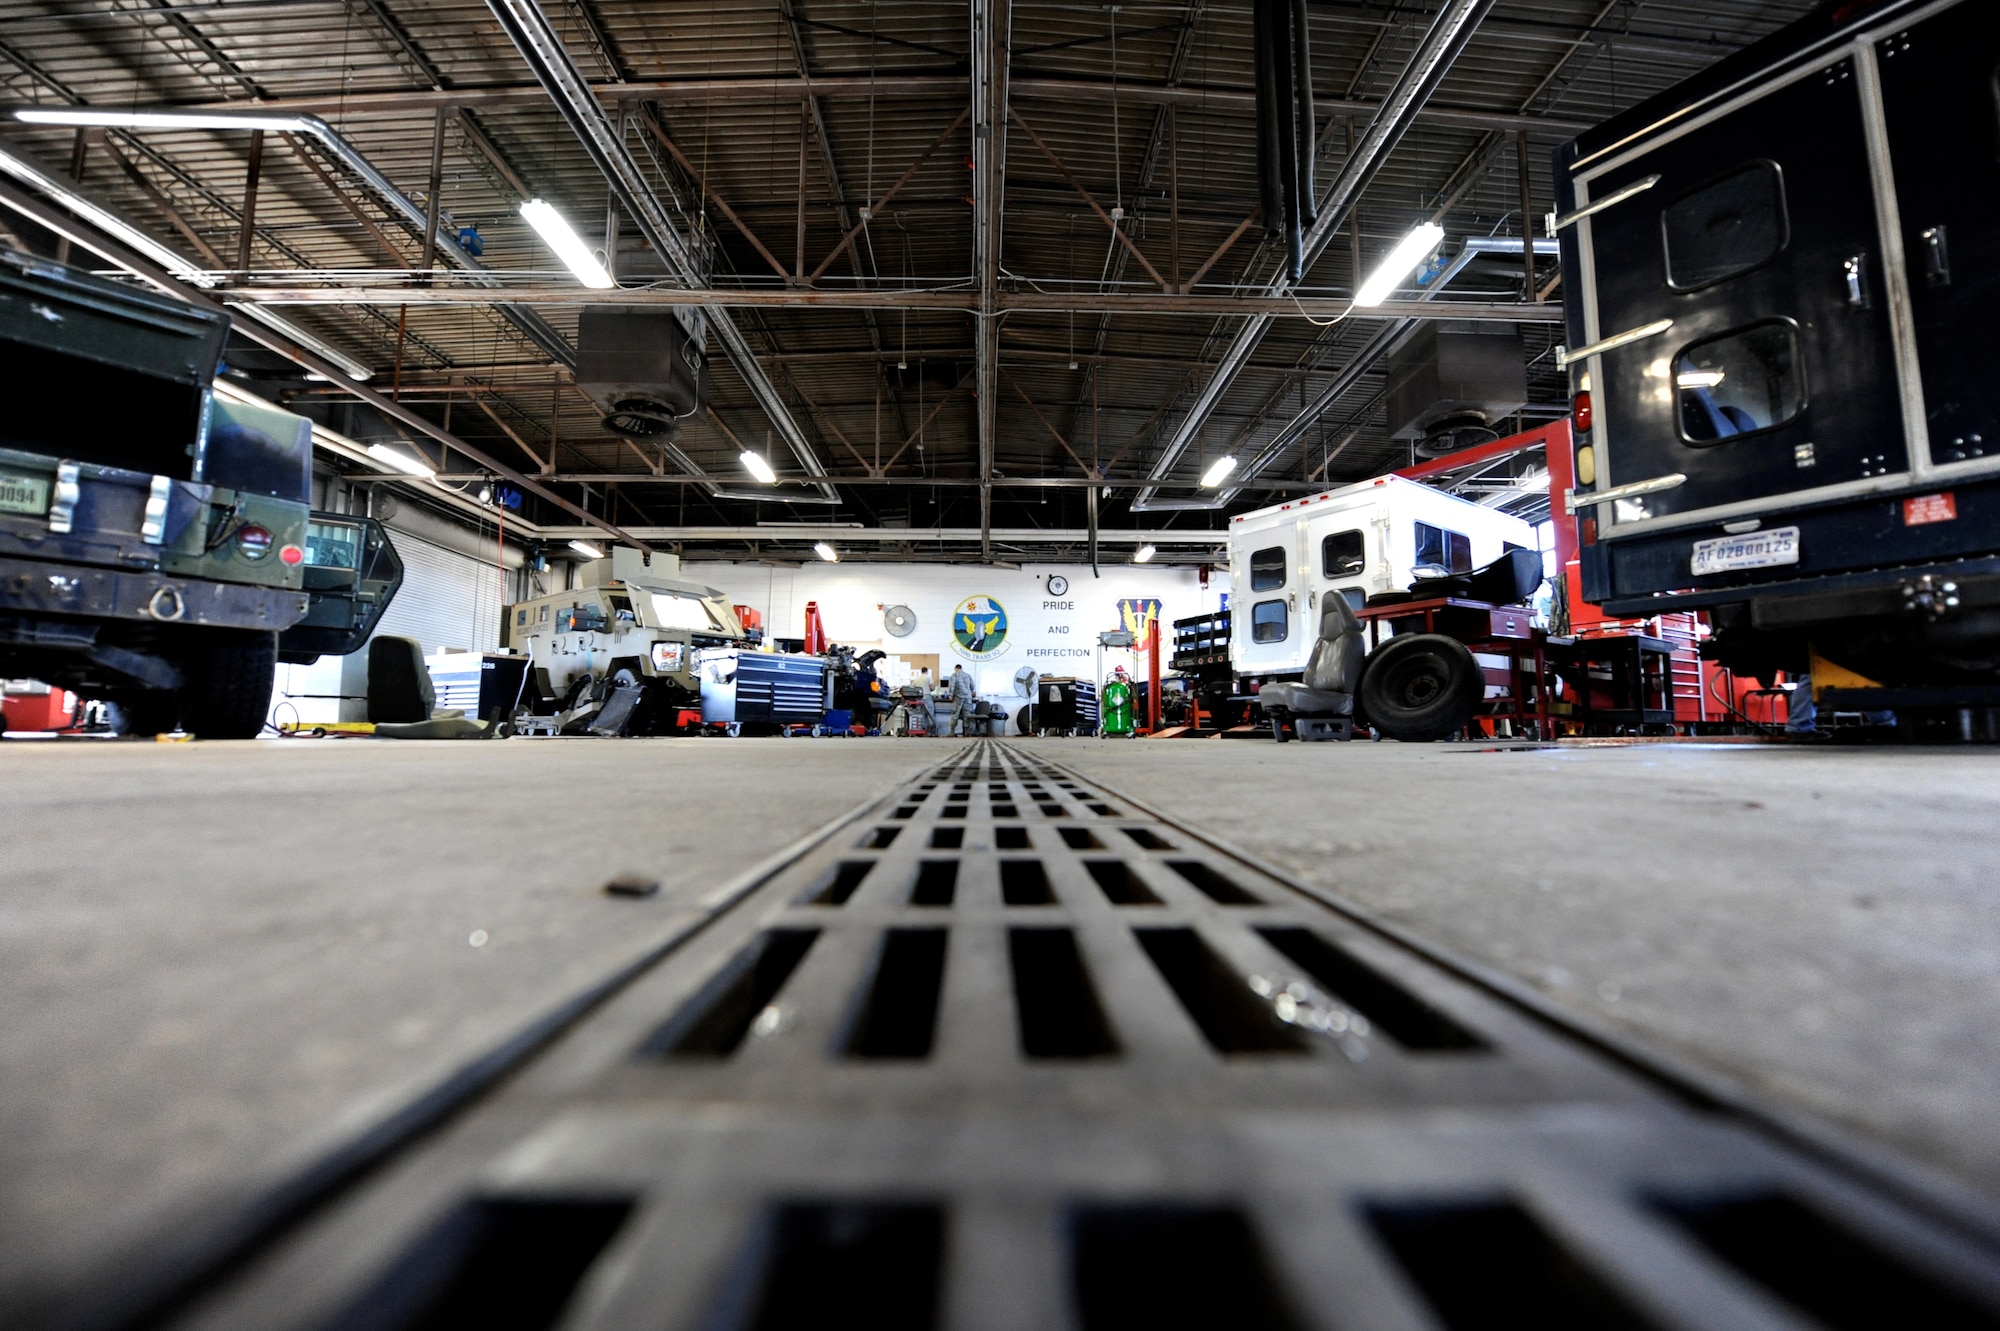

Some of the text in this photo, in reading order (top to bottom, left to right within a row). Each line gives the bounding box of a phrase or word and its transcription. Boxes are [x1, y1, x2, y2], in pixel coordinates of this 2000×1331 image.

[1043, 601, 1074, 610] PRIDE
[1048, 625, 1069, 634] AND
[1026, 648, 1090, 657] PERFECTION
